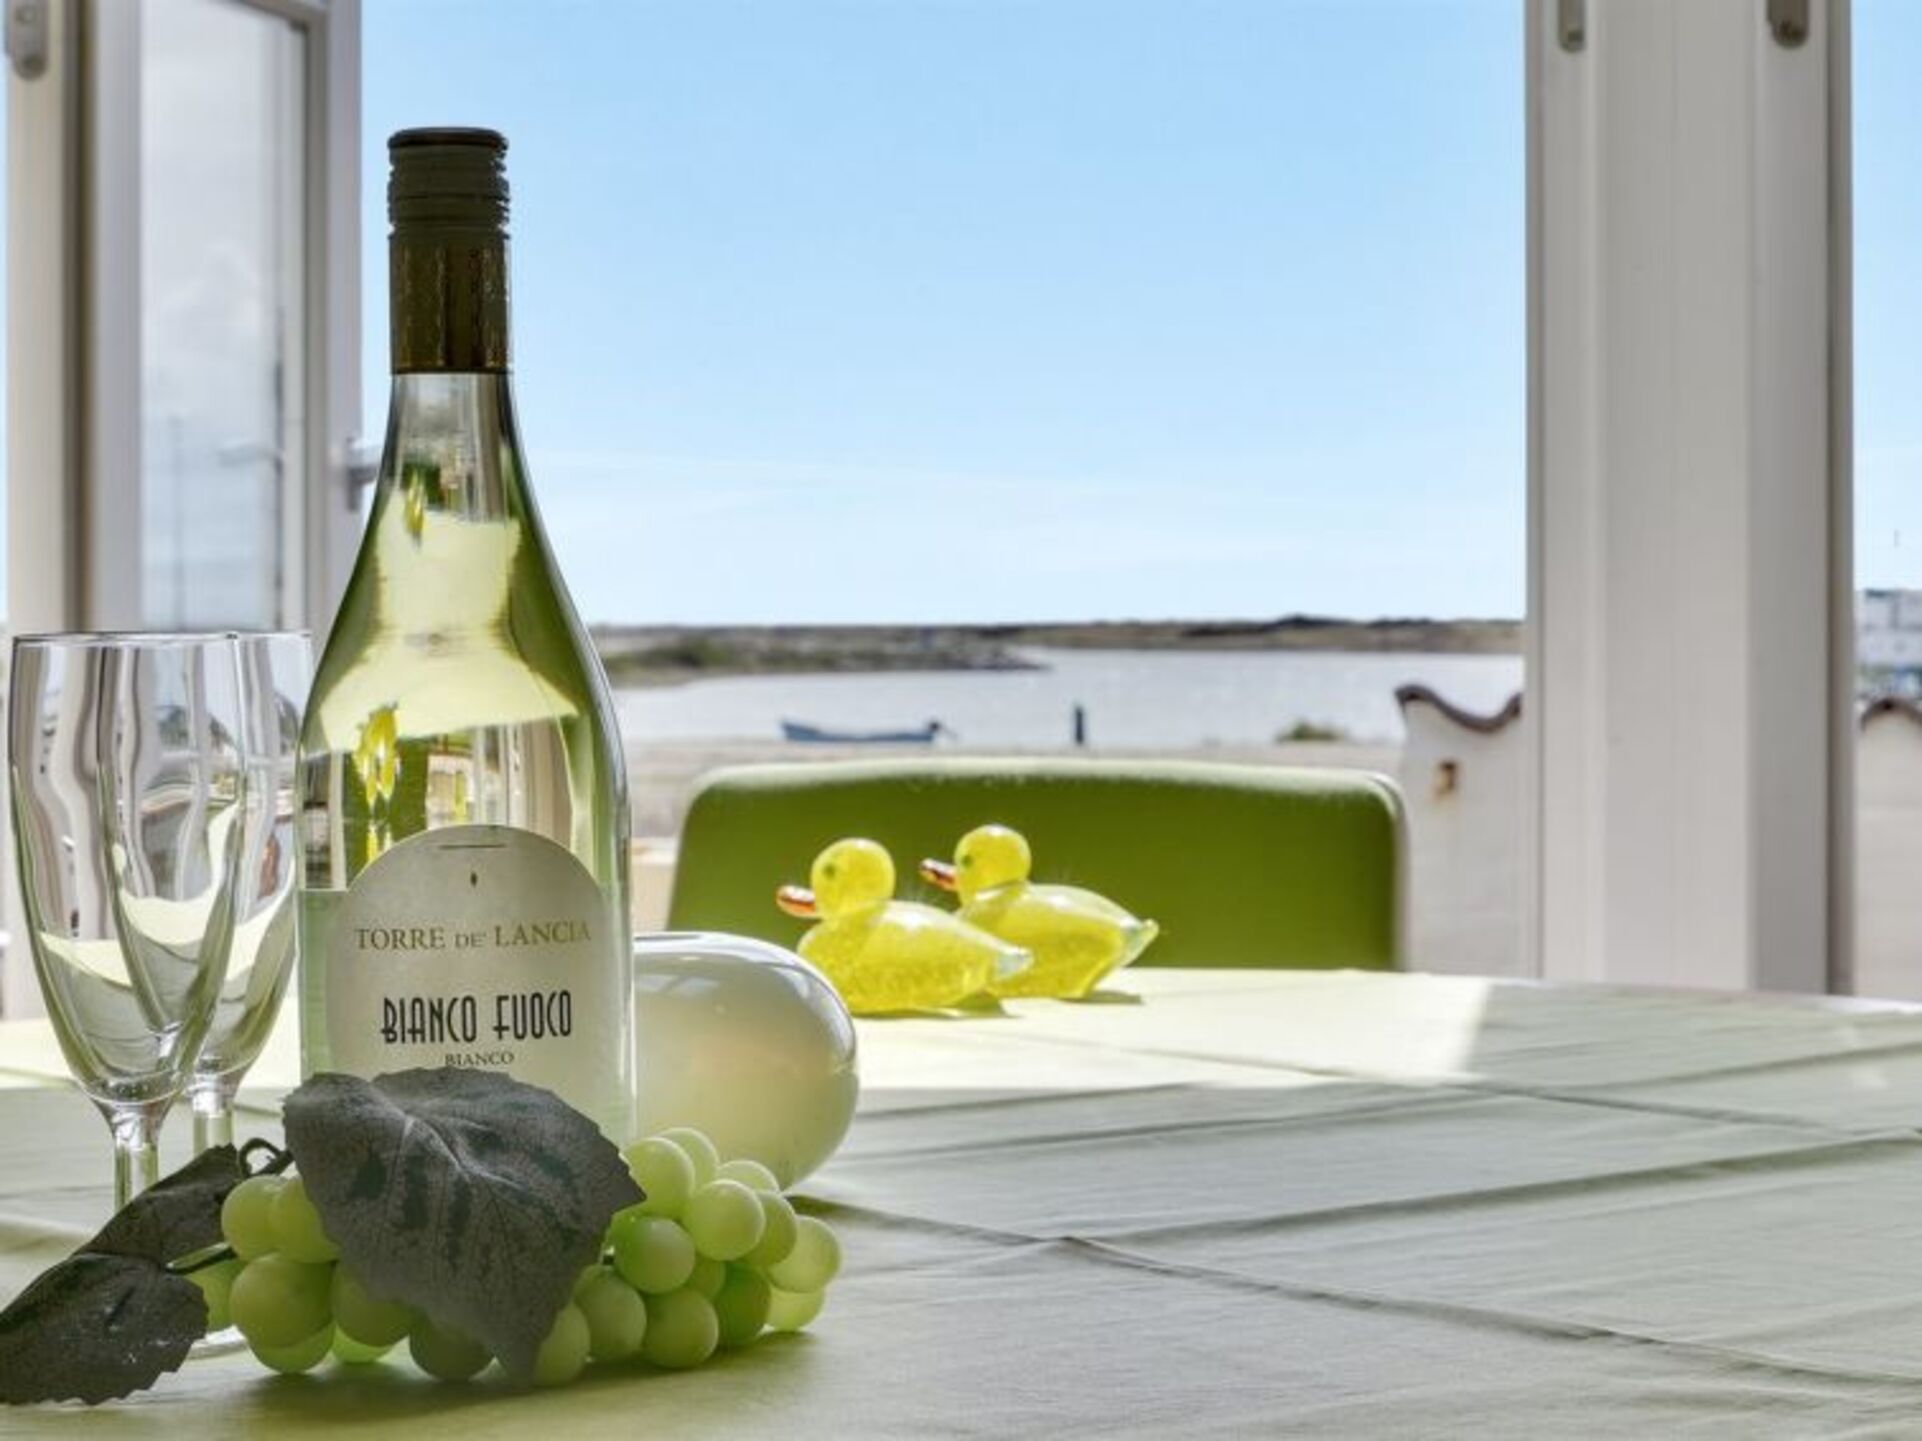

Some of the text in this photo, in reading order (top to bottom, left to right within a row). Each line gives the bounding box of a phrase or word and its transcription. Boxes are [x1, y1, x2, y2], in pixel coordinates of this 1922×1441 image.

[354, 927, 446, 950] TORRE
[494, 920, 591, 947] LANCIA
[381, 989, 572, 1044] BIANCO FUOCO
[445, 1051, 515, 1066] BIANCO
